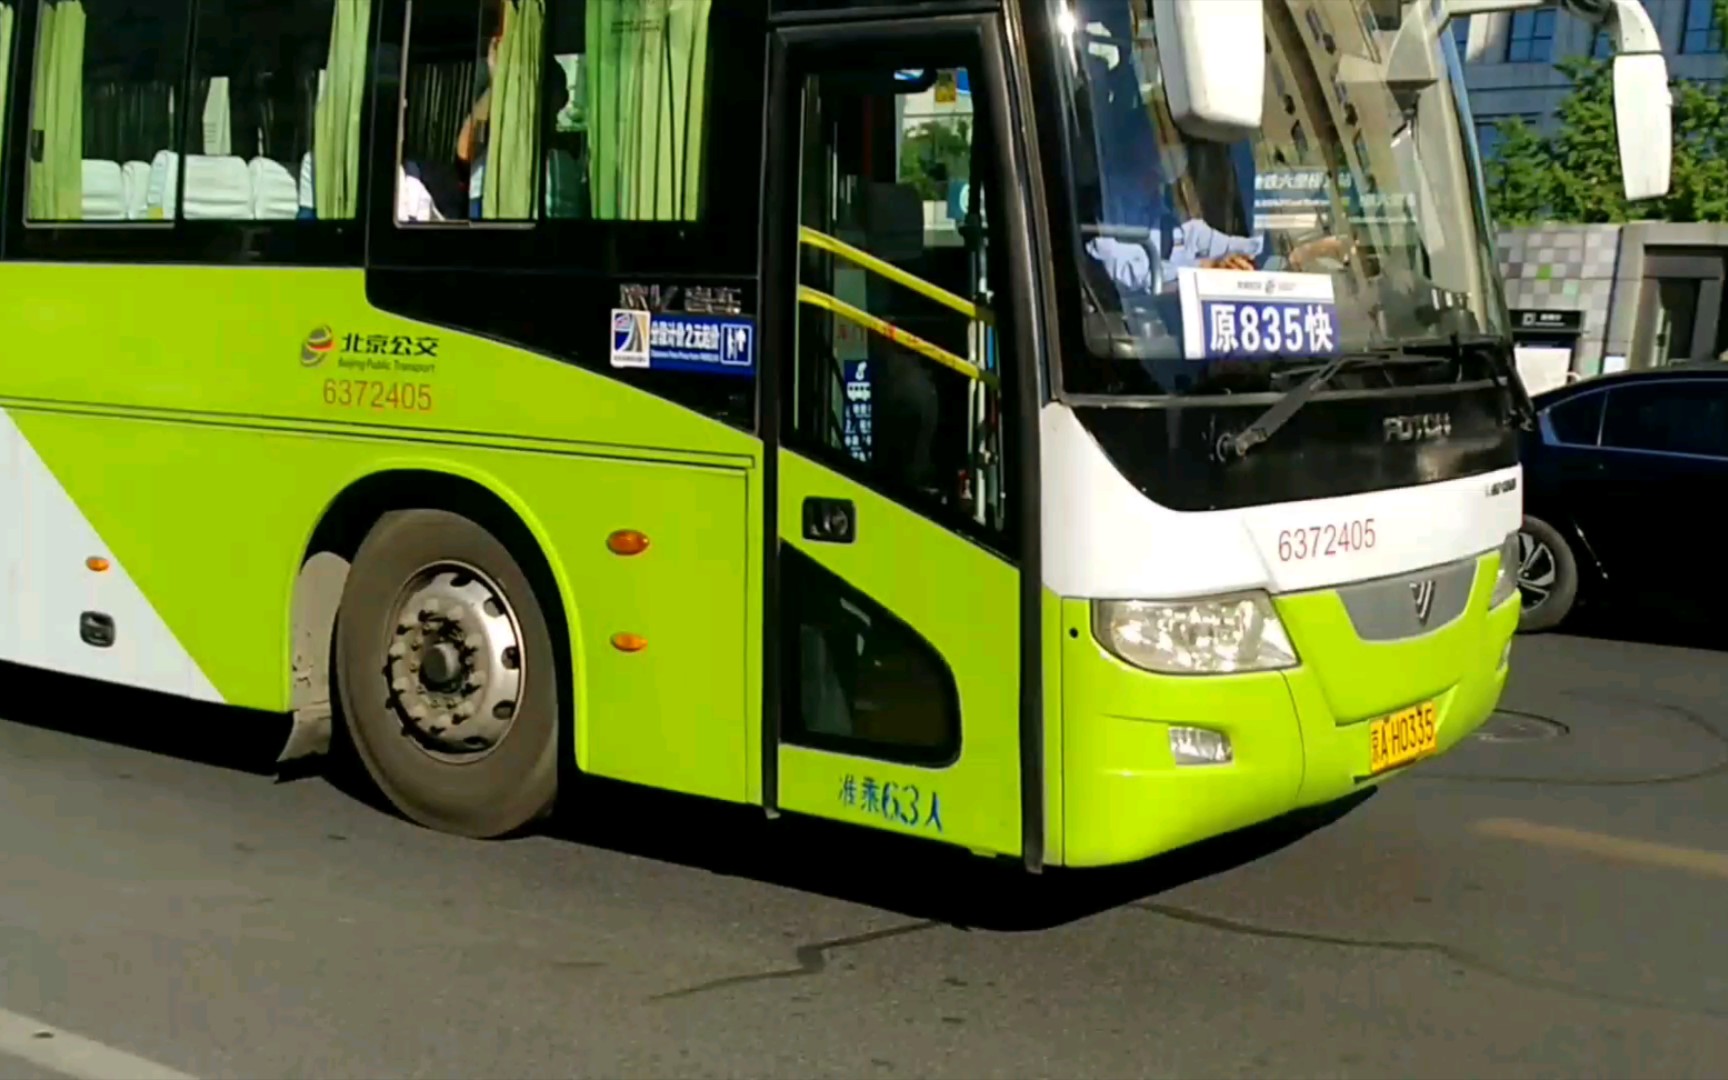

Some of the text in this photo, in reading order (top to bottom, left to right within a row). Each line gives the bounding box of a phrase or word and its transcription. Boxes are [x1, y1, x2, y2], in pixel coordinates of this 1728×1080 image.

[340, 333, 439, 357] 北京公交
[1210, 304, 1333, 352] 原835快
[323, 378, 433, 411] 6372405
[1278, 518, 1376, 562] 6372405
[838, 773, 943, 833] 准乘63人
